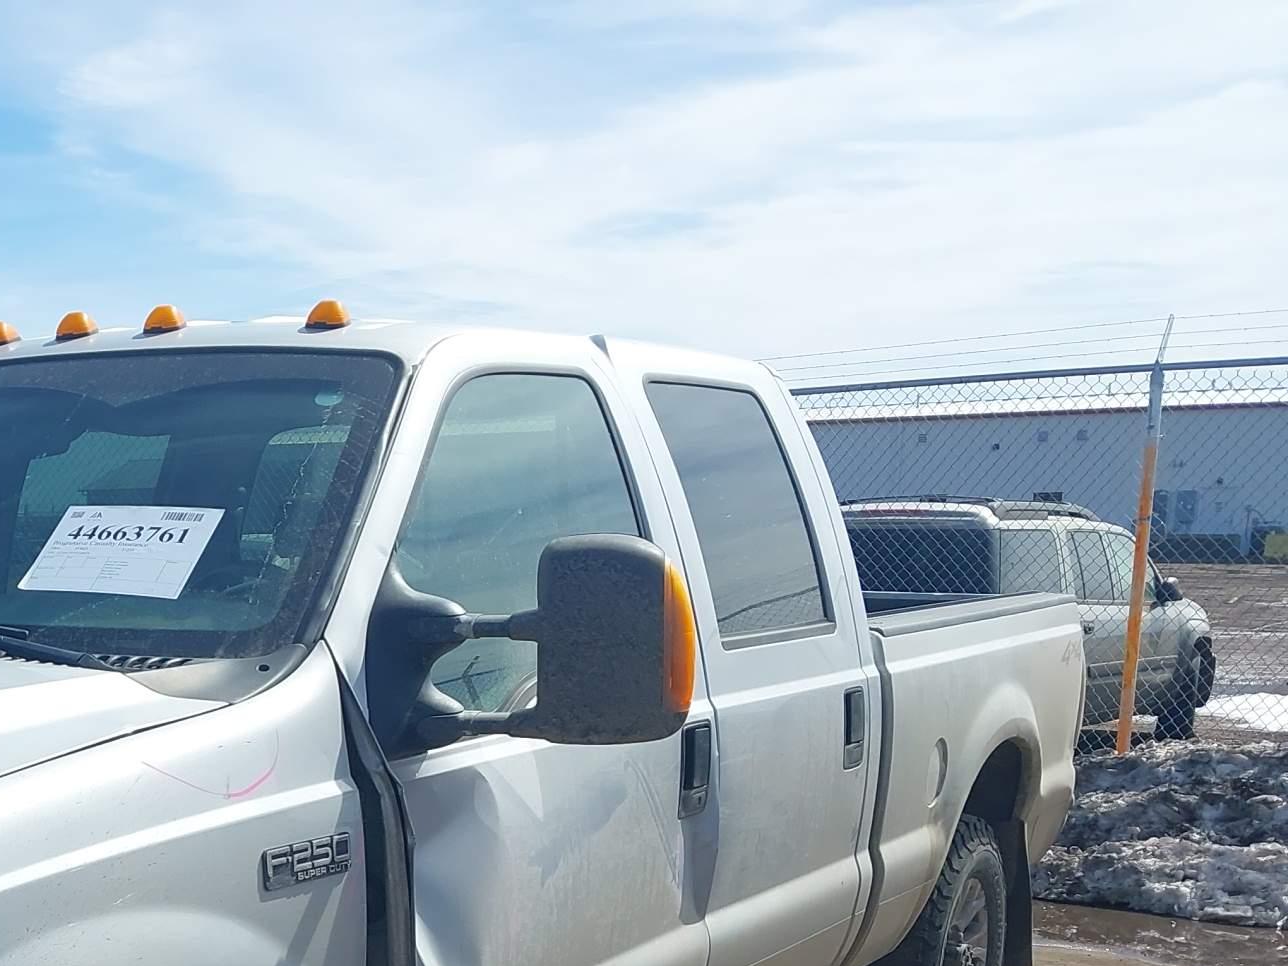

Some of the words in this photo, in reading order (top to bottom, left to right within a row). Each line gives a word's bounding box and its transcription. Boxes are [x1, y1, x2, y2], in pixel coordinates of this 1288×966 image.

[67, 524, 190, 544] 44663761
[297, 866, 328, 881] SUPER
[328, 859, 352, 873] DUTY
